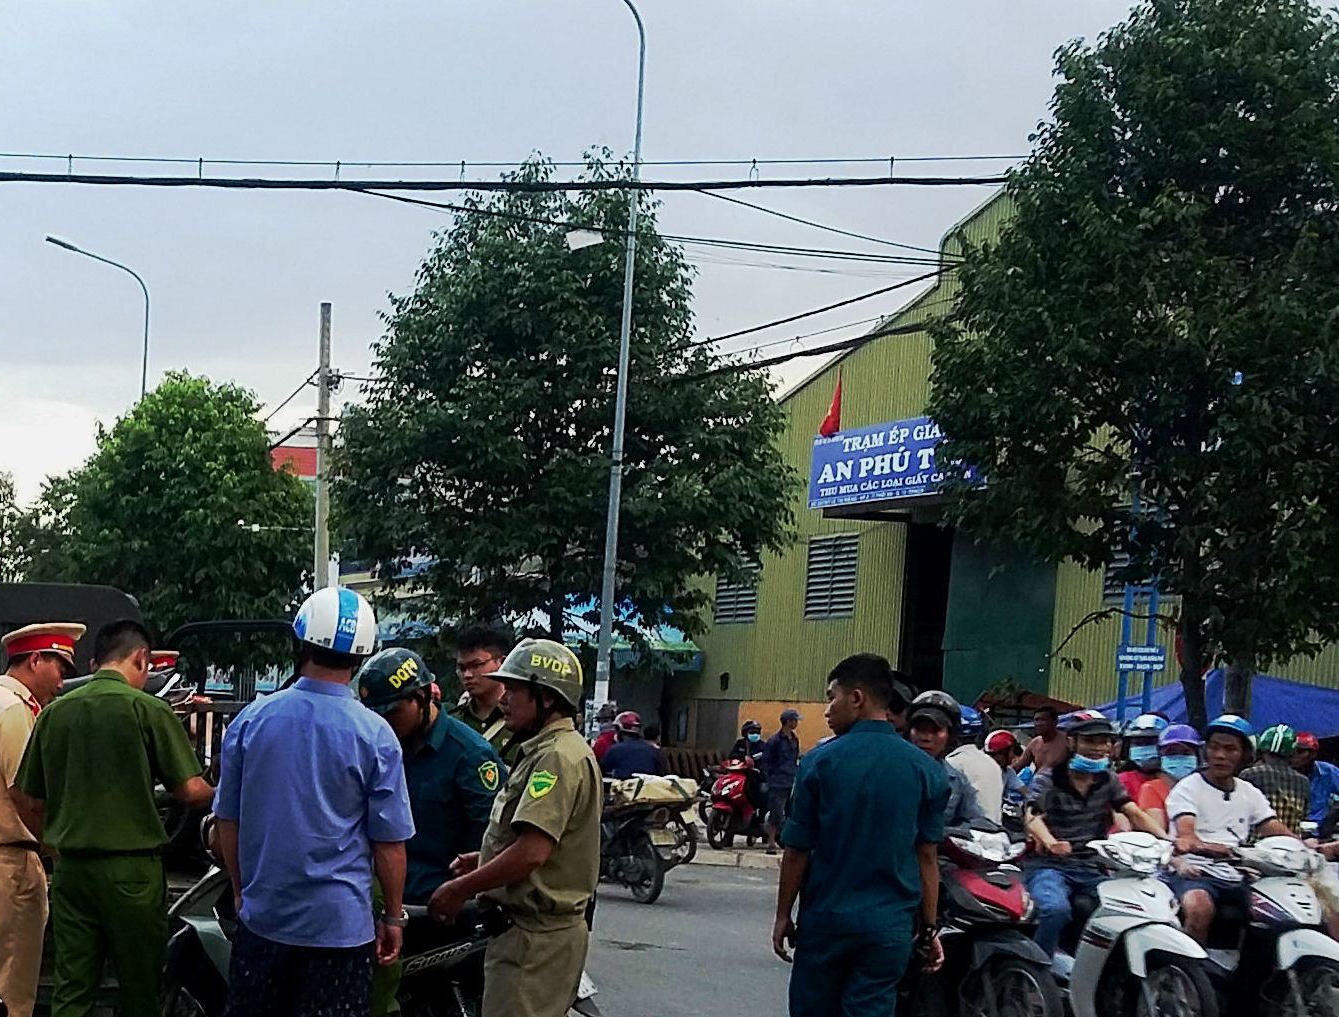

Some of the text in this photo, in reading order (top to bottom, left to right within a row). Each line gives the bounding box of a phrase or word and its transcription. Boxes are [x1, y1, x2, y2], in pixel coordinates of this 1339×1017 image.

[843, 432, 885, 453] TRẠM
[888, 426, 910, 445] ÉP
[817, 459, 854, 484] AN
[858, 446, 911, 478] PHÚ
[820, 487, 838, 498] THU
[839, 485, 859, 495] MUA
[860, 480, 880, 492] CÁC
